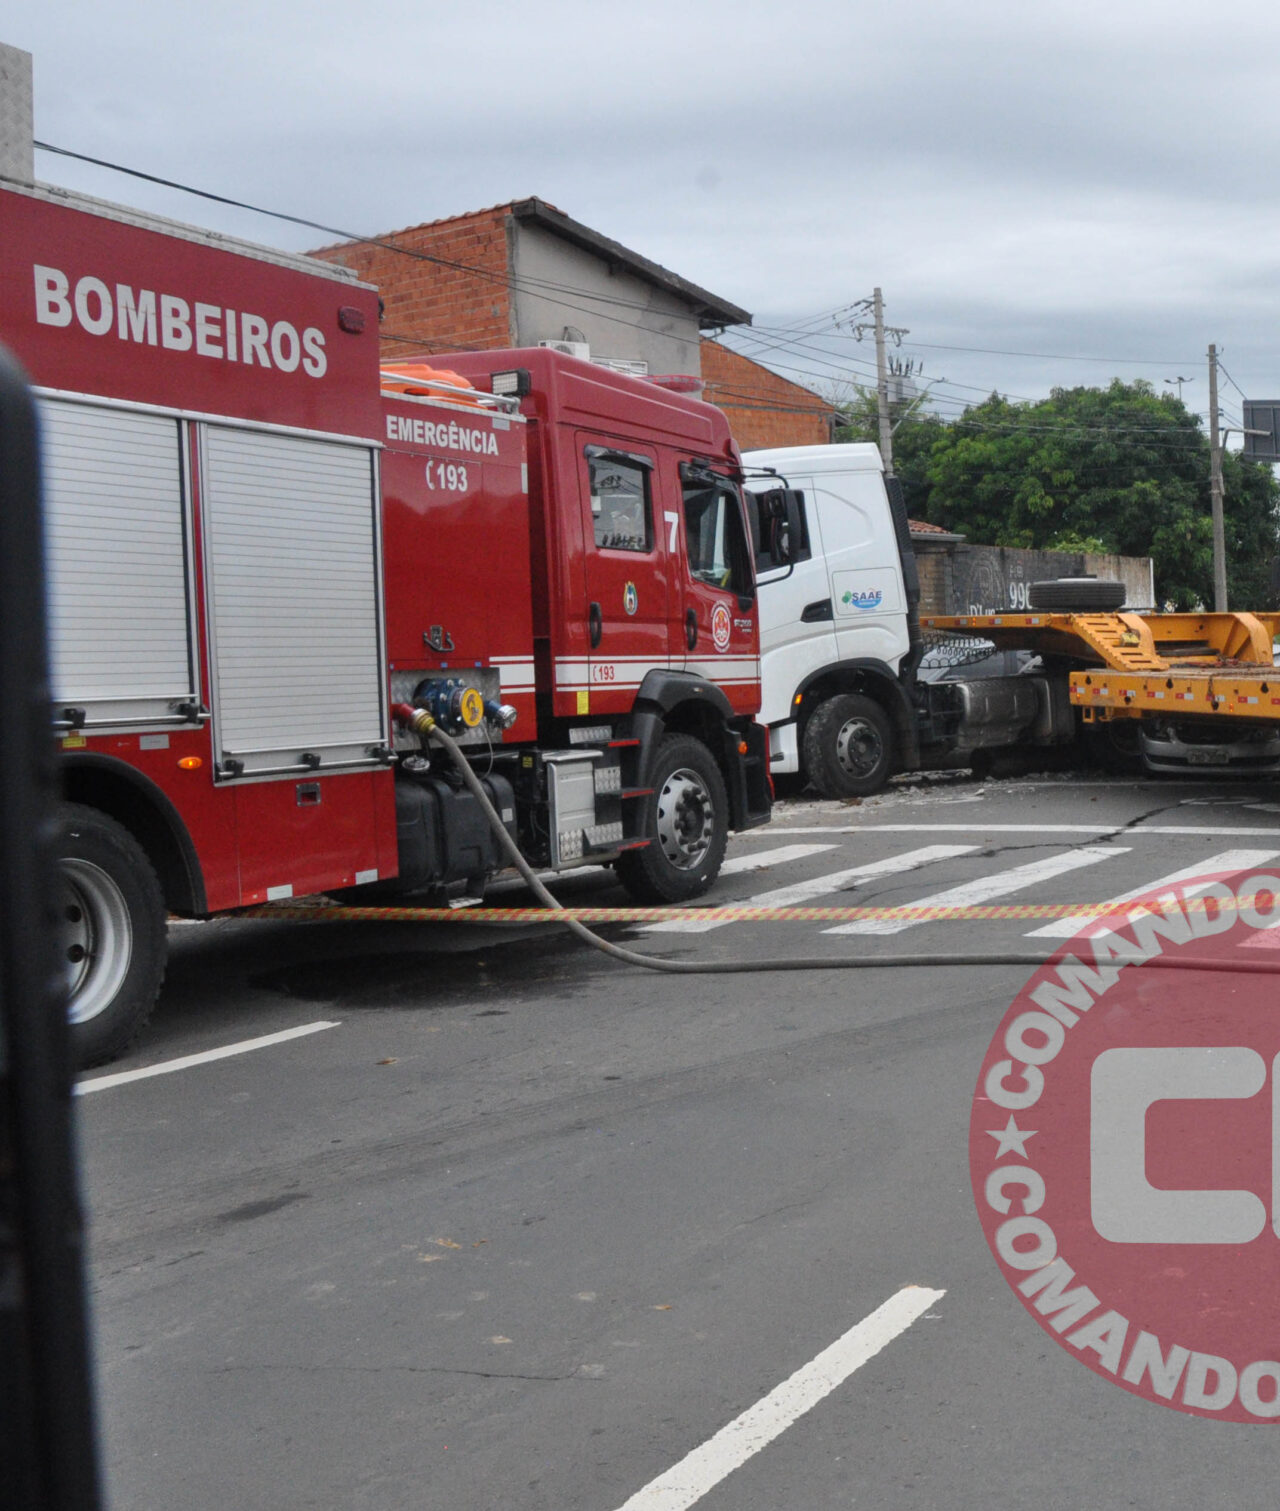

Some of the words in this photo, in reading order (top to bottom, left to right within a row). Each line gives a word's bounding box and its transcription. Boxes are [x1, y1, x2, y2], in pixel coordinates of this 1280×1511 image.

[33, 264, 328, 378] BOMBEIROS
[386, 414, 499, 456] EMERGÊNCIA
[437, 463, 468, 492] 193
[664, 511, 679, 553] 7
[852, 591, 882, 602] SAAE
[599, 665, 615, 680] 193
